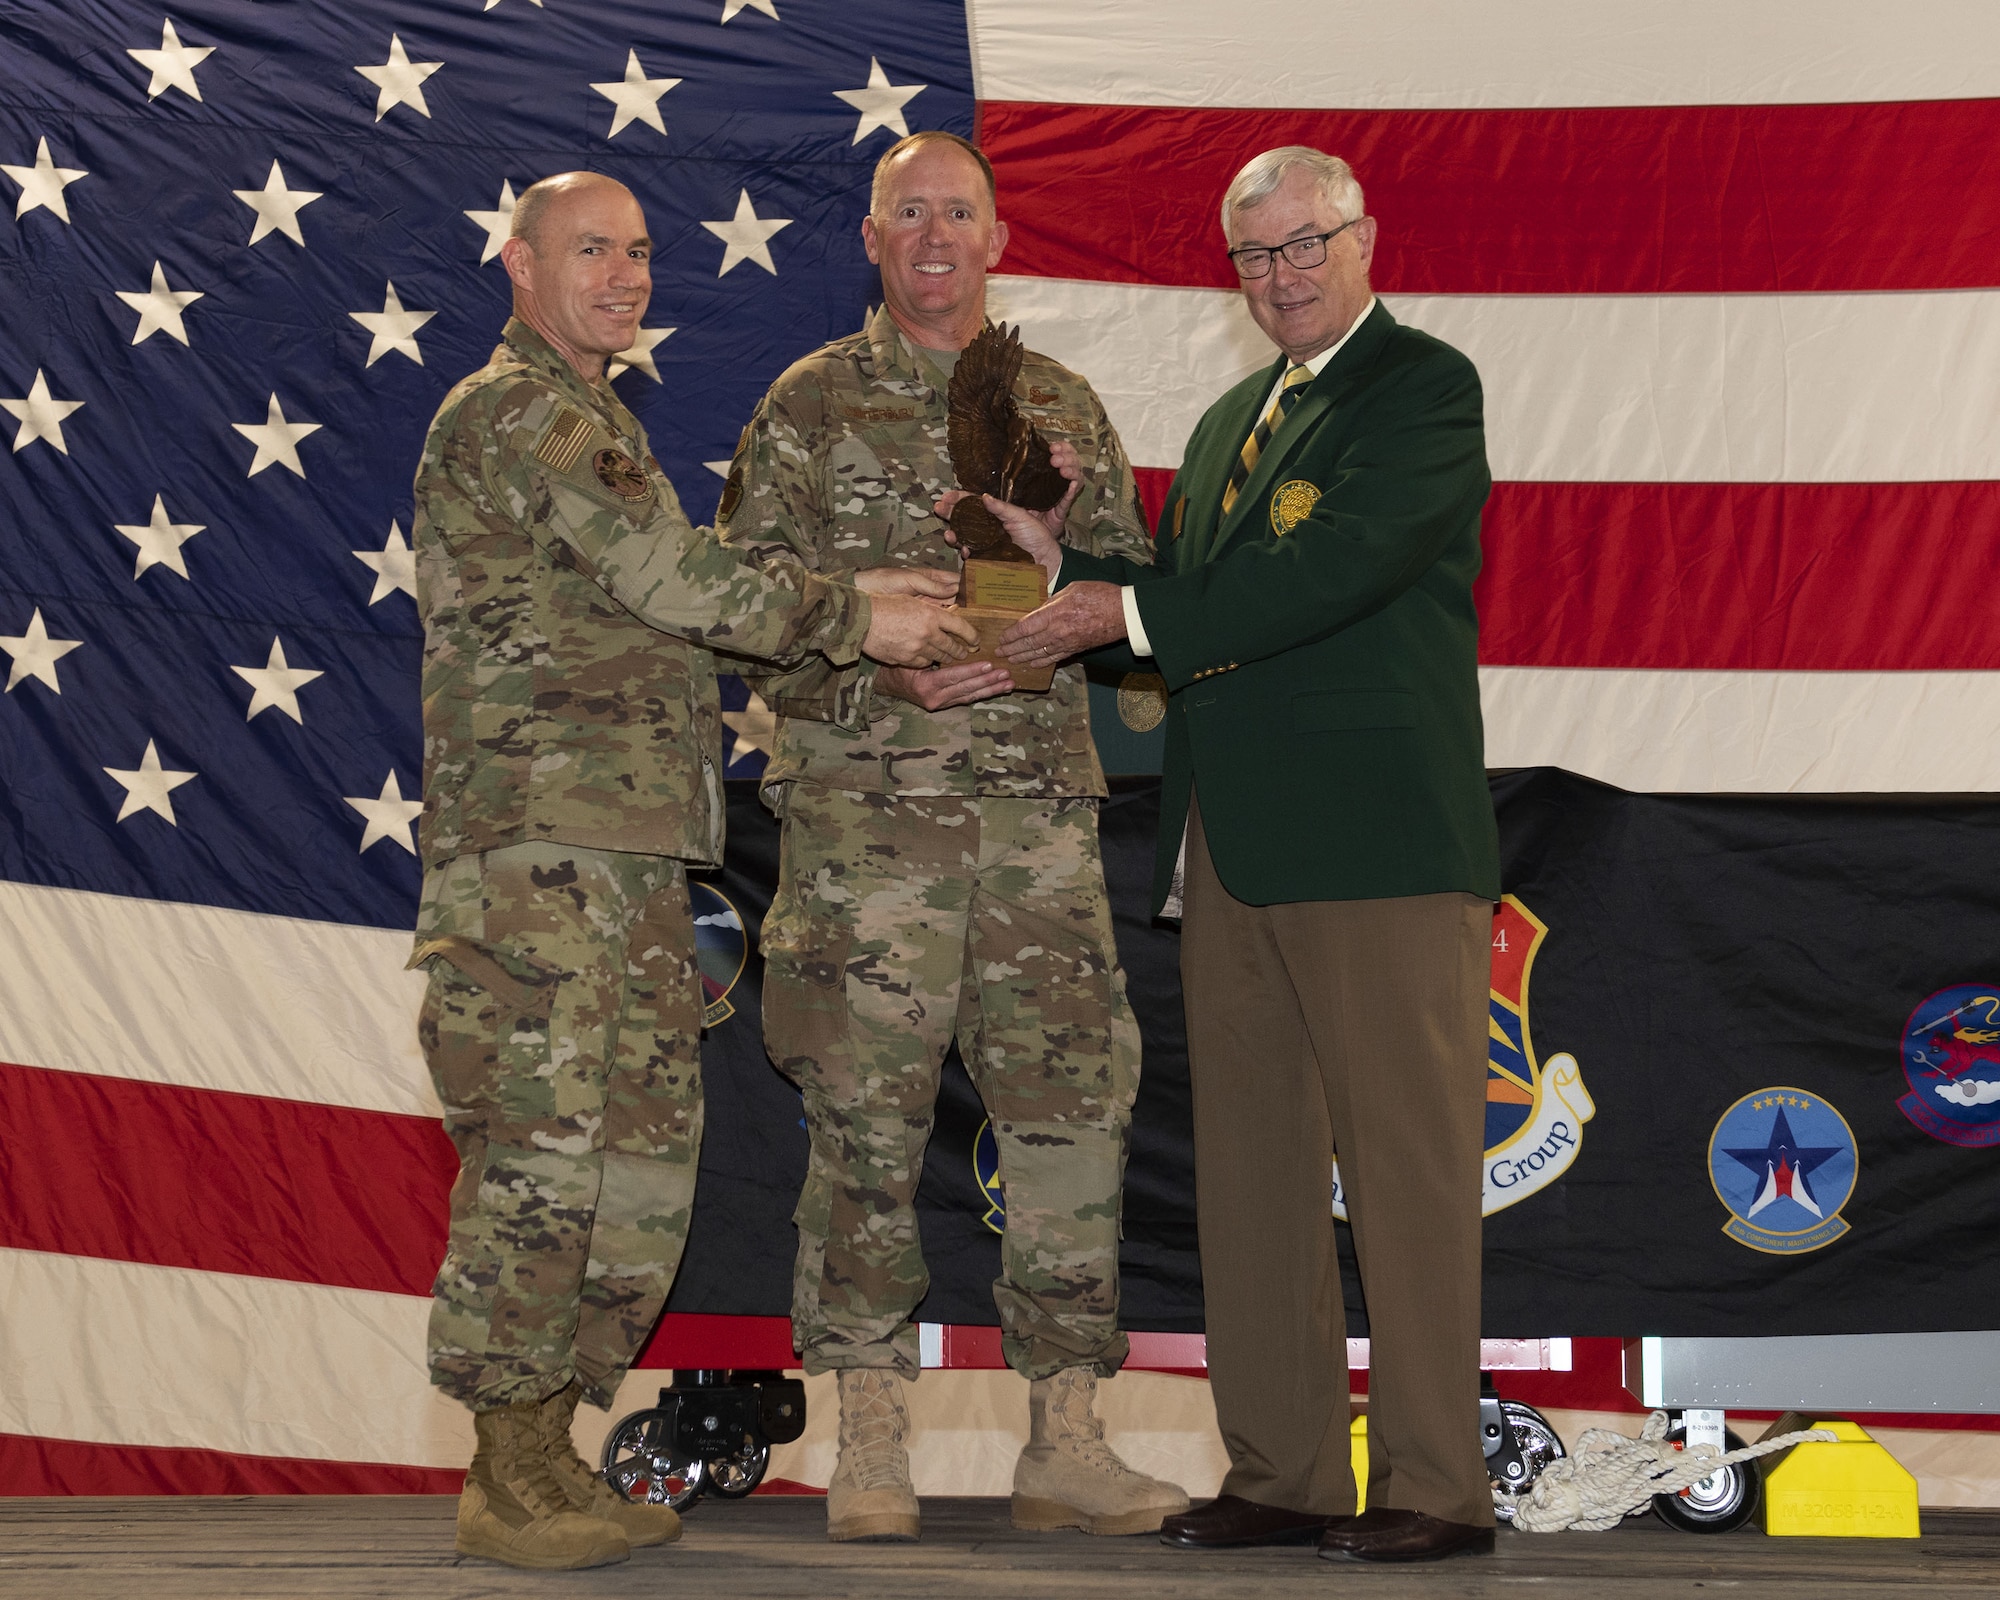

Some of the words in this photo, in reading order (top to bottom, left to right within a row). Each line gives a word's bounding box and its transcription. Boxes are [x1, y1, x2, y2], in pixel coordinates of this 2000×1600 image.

[1048, 416, 1084, 432] FORCE
[715, 1005, 725, 1014] SQ
[1489, 1120, 1577, 1189] Group
[1787, 1229, 1832, 1248] MAINTENANCE
